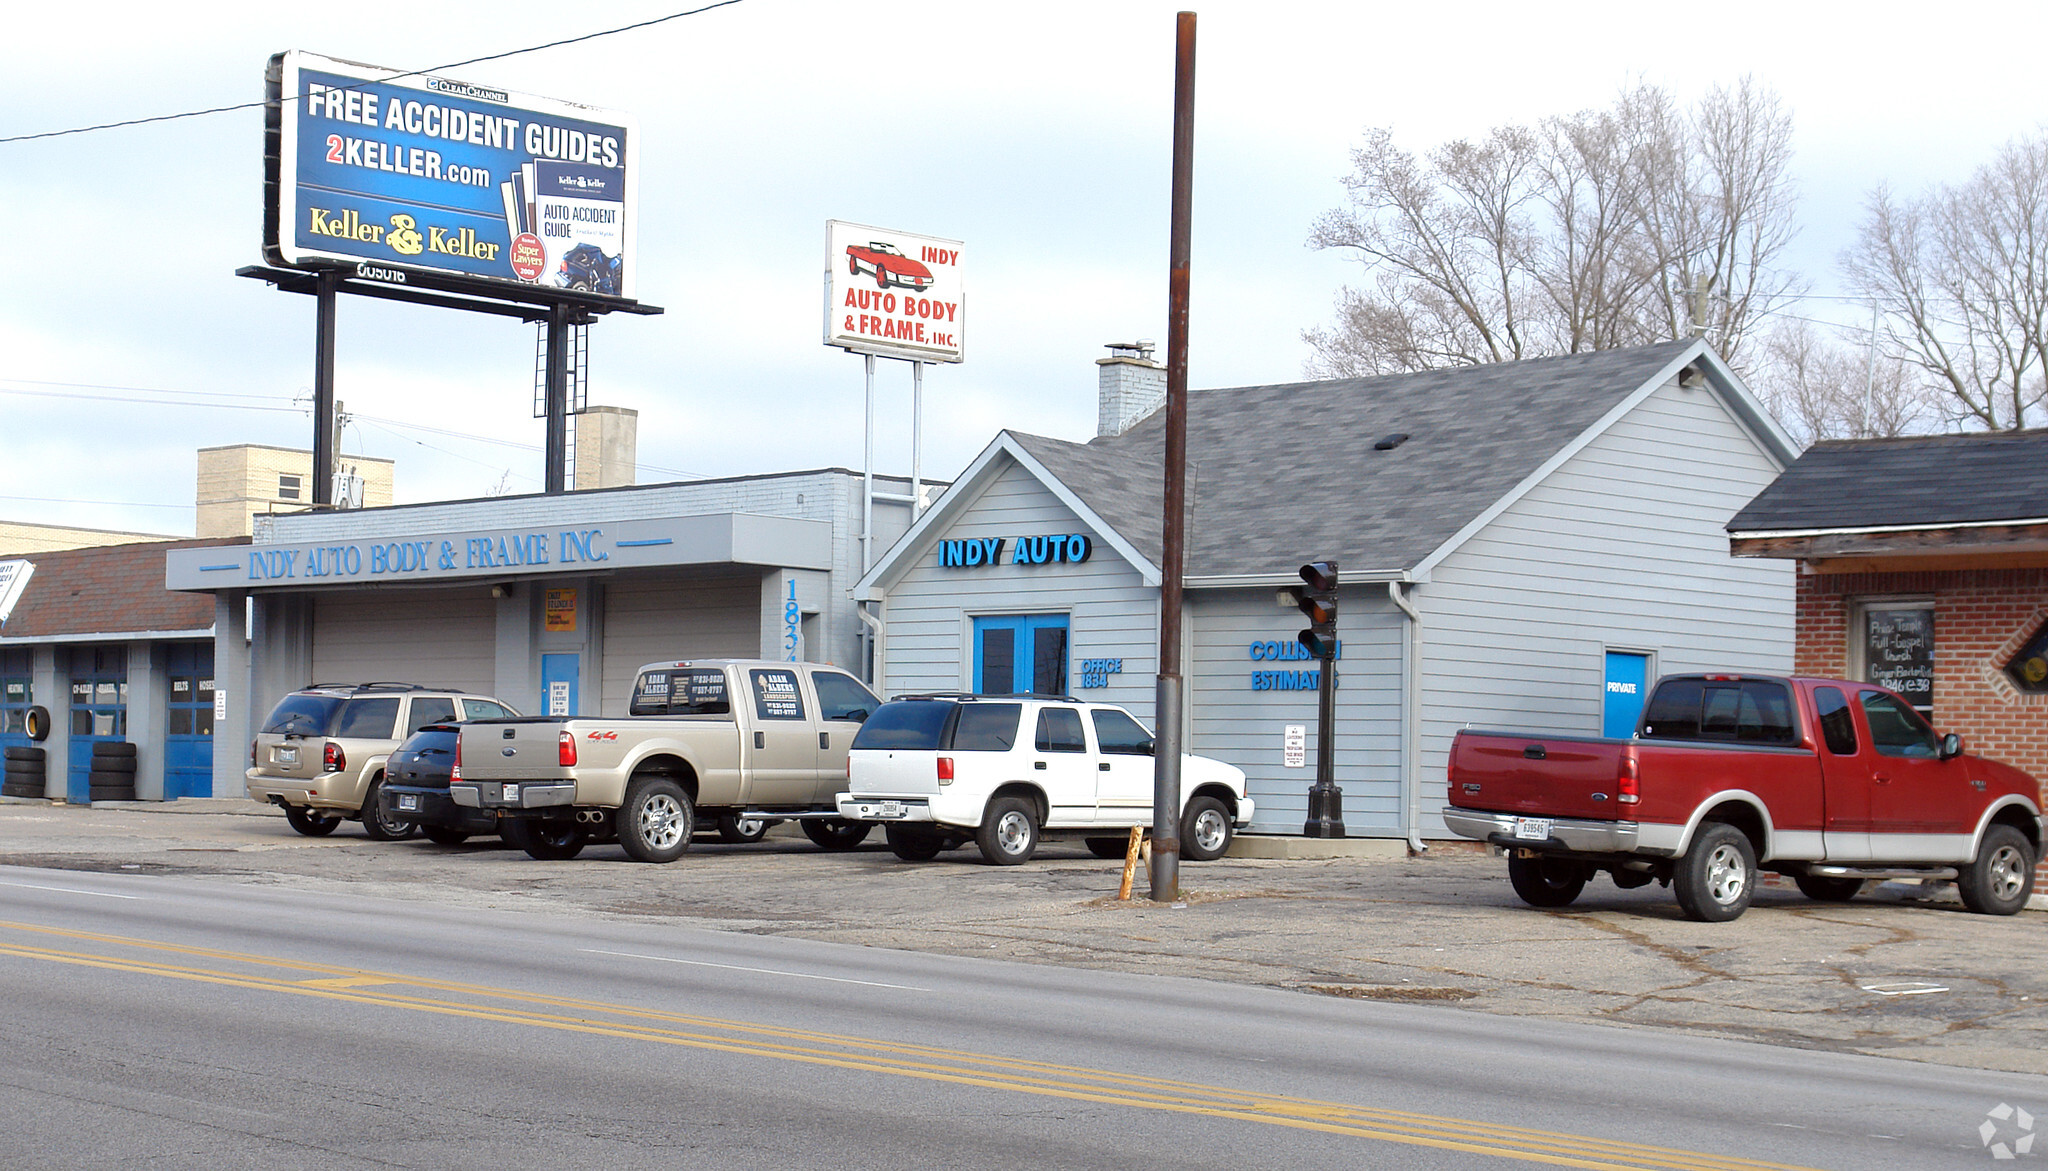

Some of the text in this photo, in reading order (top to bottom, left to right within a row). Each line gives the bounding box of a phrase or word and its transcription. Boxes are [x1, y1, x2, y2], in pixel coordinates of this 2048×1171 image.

[308, 82, 619, 168] FREE ACCIDENT GUIDES
[326, 134, 490, 188] 2KELLER.com
[558, 175, 606, 188] Keller & Keller
[544, 204, 616, 224] AUTO ACCIDENT
[309, 207, 500, 261] Keller & Keller
[544, 222, 572, 238] GUIDE
[517, 243, 540, 256] Super
[921, 245, 959, 266] INDY
[513, 252, 543, 266] Lawyers
[845, 287, 957, 322] AUTO BODY
[844, 314, 957, 347] & FRAME, INC.
[248, 528, 609, 580] INDY AUTO BODY & FRAME INC.
[938, 534, 1088, 567] INDY AUTO
[1081, 658, 1122, 674] OFFICE
[648, 674, 666, 685] ADAM
[768, 674, 788, 683] ADAM
[1081, 674, 1108, 688] 1834
[644, 684, 669, 694] ALBERS
[768, 683, 794, 692] ALBERS
[1607, 681, 1637, 694] PRIVATE
